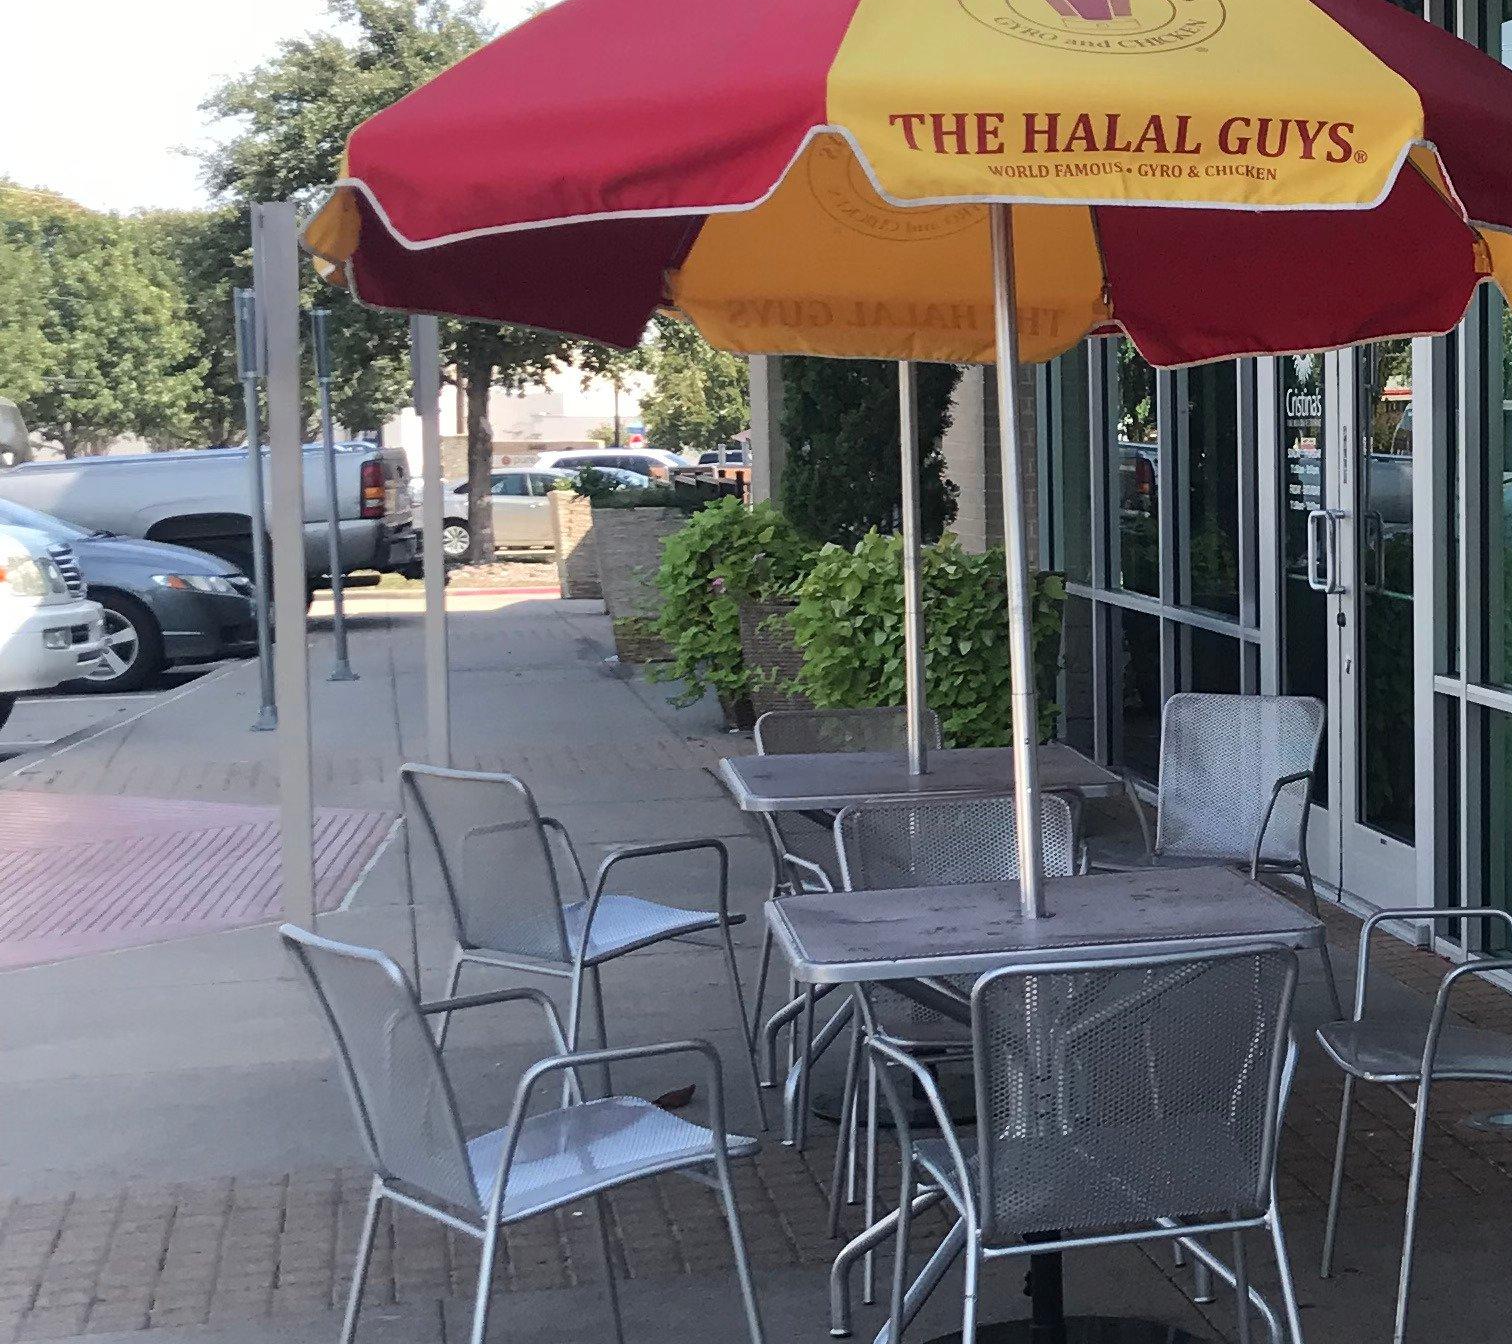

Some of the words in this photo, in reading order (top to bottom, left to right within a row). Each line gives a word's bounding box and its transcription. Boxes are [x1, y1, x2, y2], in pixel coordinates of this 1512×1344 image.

[993, 16, 1059, 41] GYRO
[1065, 38, 1111, 48] and
[1117, 18, 1208, 49] CHICKEN
[888, 112, 1005, 155] THE
[1022, 112, 1202, 155] HALAL
[988, 164, 1050, 179] WORLD
[1137, 163, 1182, 179] GYRO
[1187, 163, 1200, 179] &
[1204, 163, 1278, 181] CHICKEN
